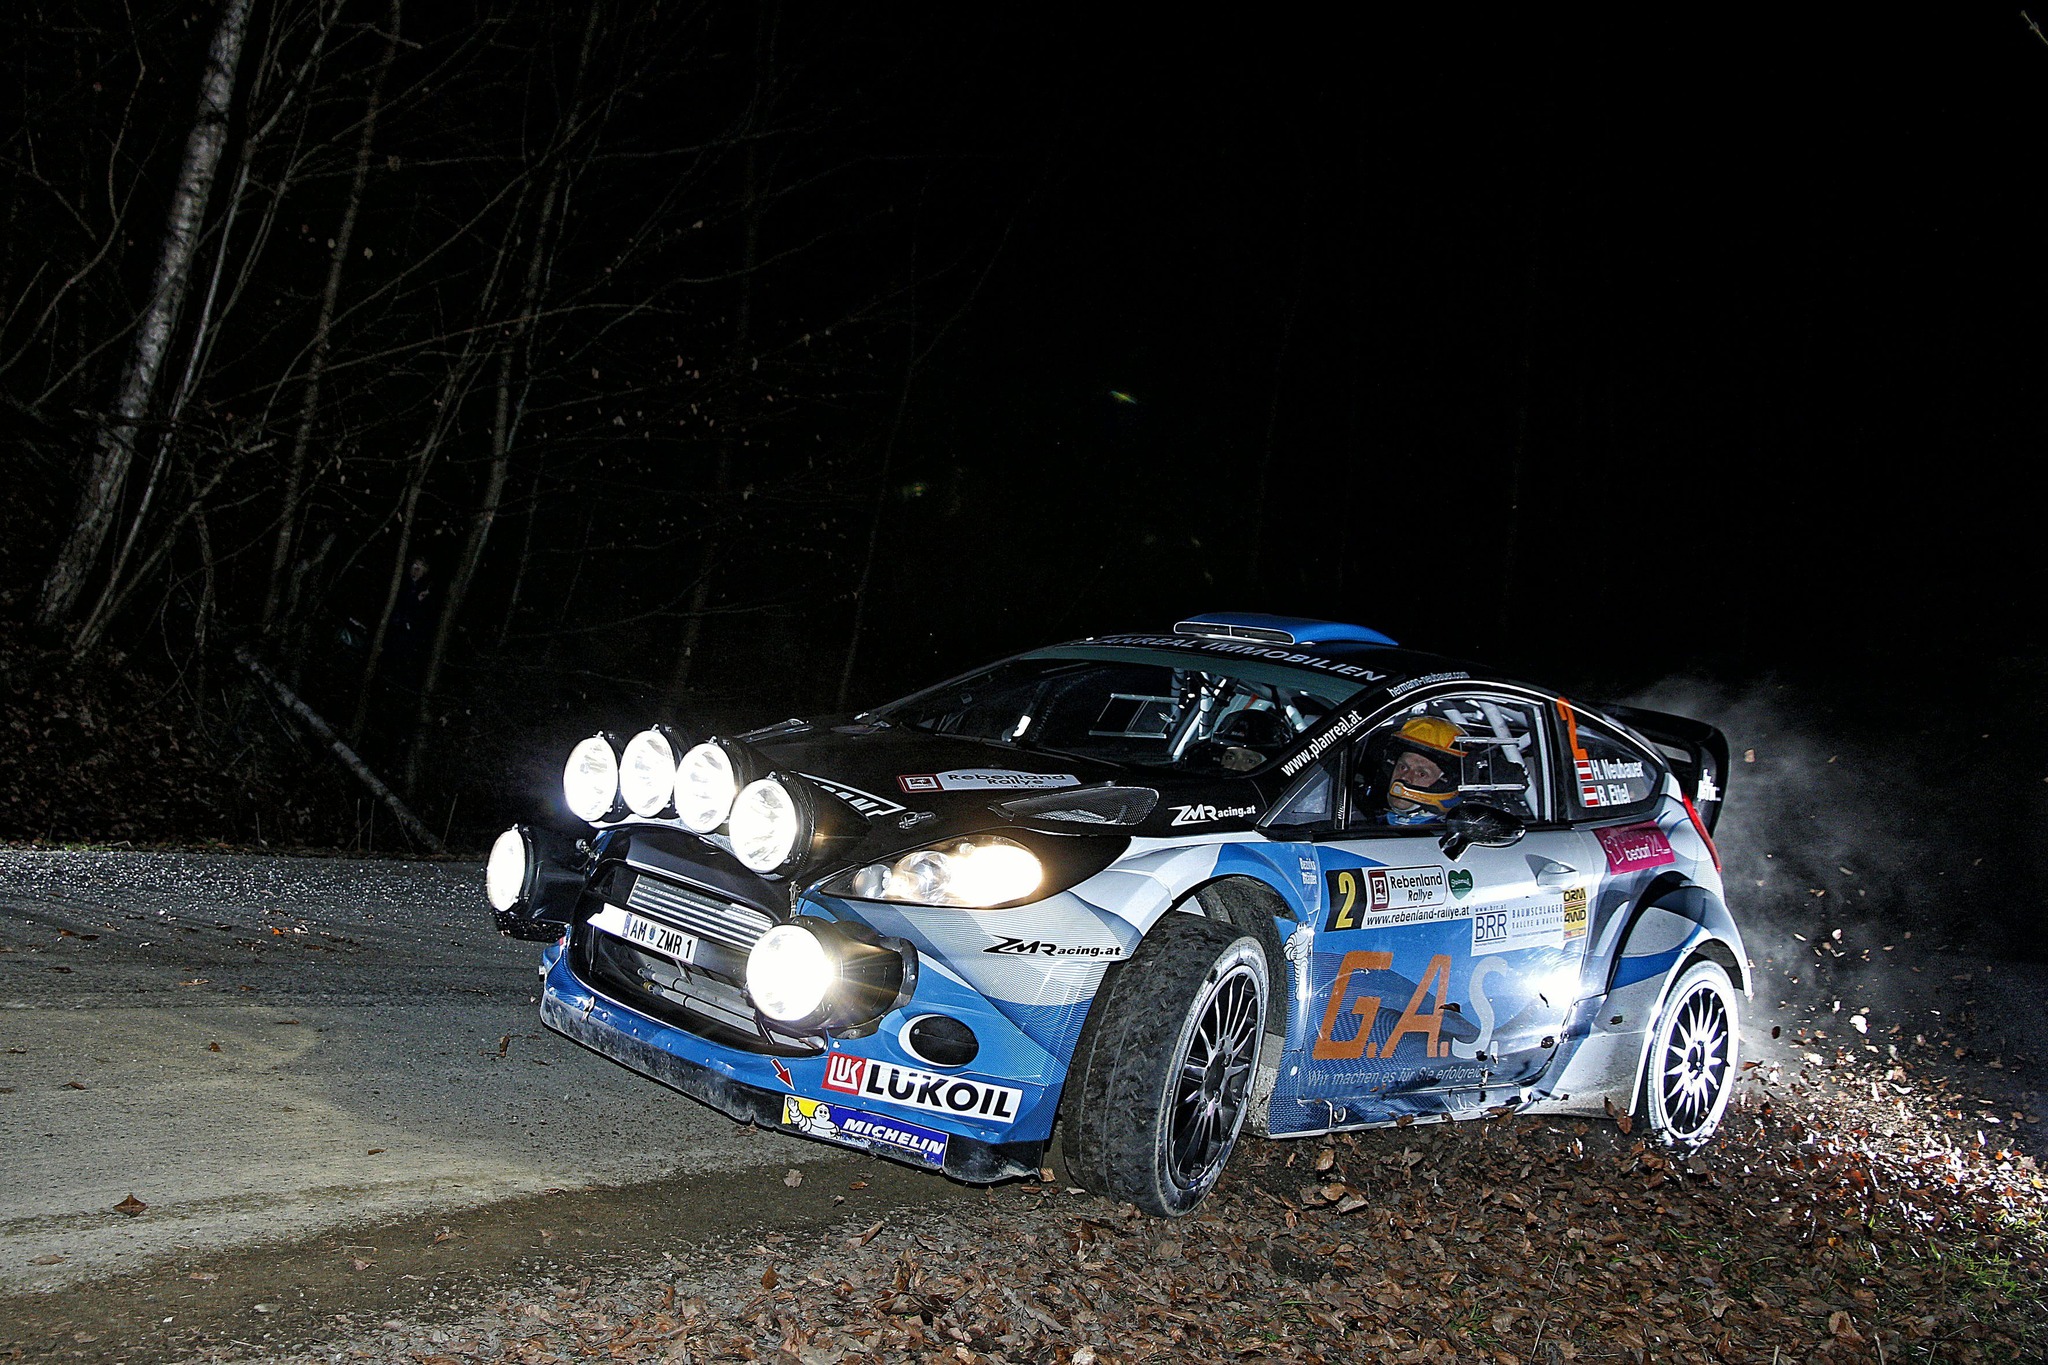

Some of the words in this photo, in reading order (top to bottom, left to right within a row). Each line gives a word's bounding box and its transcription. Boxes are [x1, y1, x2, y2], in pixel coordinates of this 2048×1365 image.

[1201, 642, 1387, 682] IMMOBILIEN
[1280, 709, 1363, 777] www.planreal.at
[1556, 696, 1589, 760] 2
[987, 778, 1044, 786] Rallye
[1335, 871, 1357, 930] 2
[1389, 872, 1444, 890] Rebenland
[1407, 888, 1434, 903] Rallye
[1366, 905, 1470, 926] www.rebenland-rallye.at
[1475, 913, 1508, 940] BRR
[629, 919, 648, 942] AM
[656, 928, 683, 956] ZMR
[685, 939, 693, 959] 1
[865, 1063, 1013, 1119] LUKOIL
[1307, 1069, 1330, 1087] Wir
[1331, 1068, 1380, 1085] machen
[1381, 1070, 1397, 1084] es
[1399, 1069, 1418, 1082] für
[1418, 1066, 1435, 1082] Sie
[841, 1117, 946, 1156] MICHELIN
